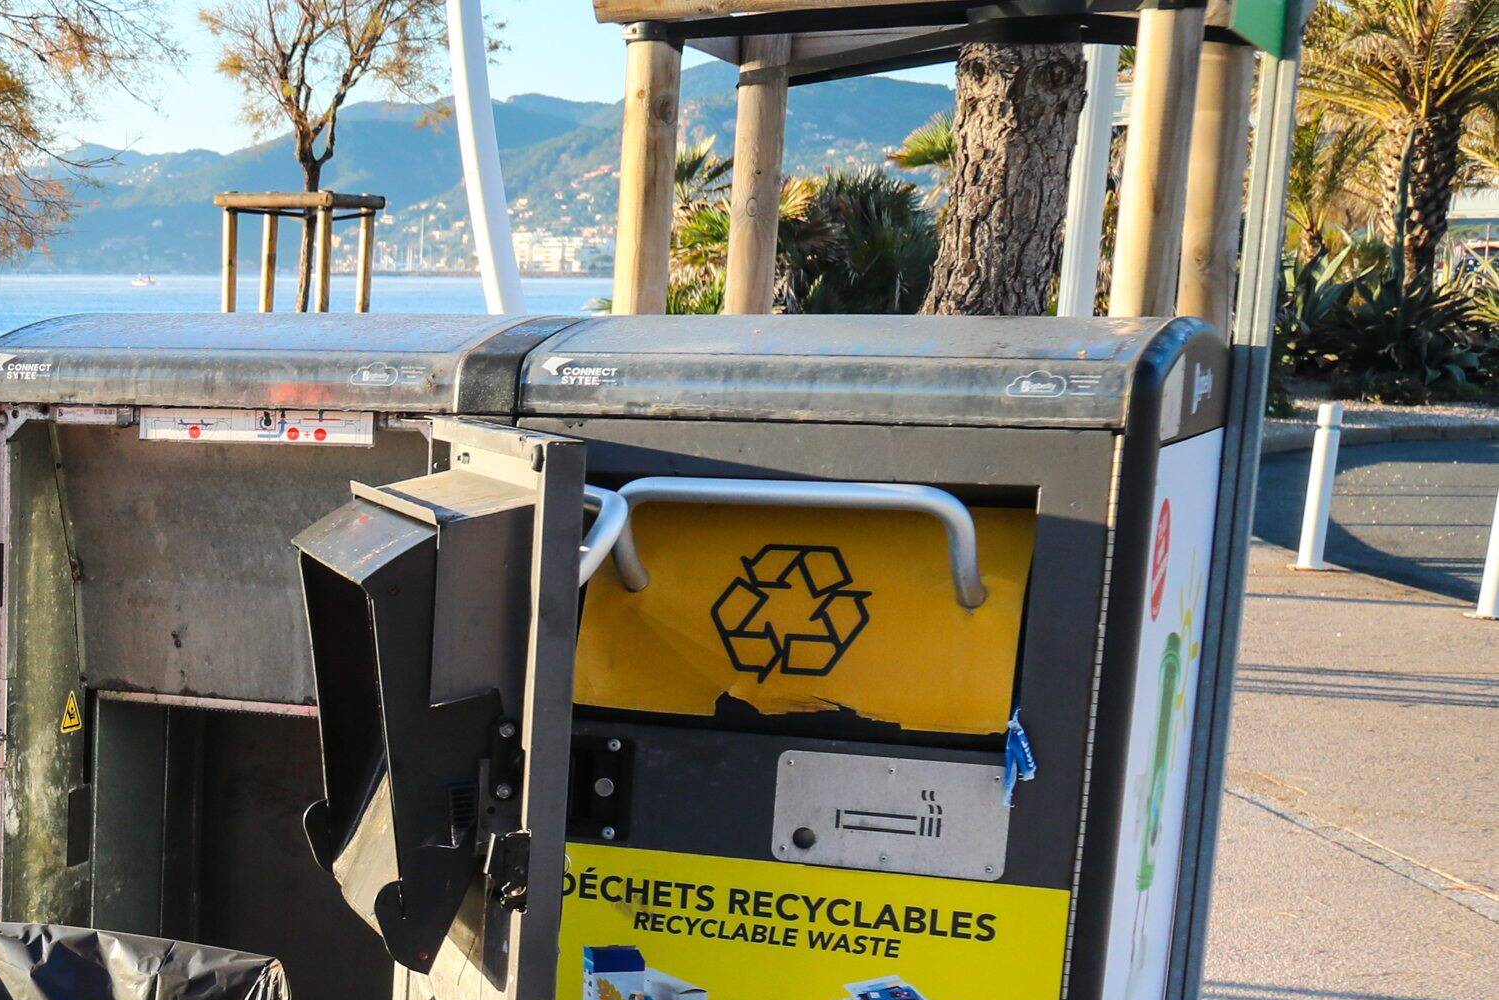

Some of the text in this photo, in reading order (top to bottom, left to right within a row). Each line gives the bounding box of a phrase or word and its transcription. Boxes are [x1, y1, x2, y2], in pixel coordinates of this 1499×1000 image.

[7, 363, 52, 372] CONNECT
[562, 367, 618, 377] CONNECT
[6, 371, 37, 380] SYTEE
[560, 376, 601, 386] SYTEE
[728, 887, 997, 942] RECYCLABLES
[633, 911, 902, 959] RECYCLABLE WASTE
